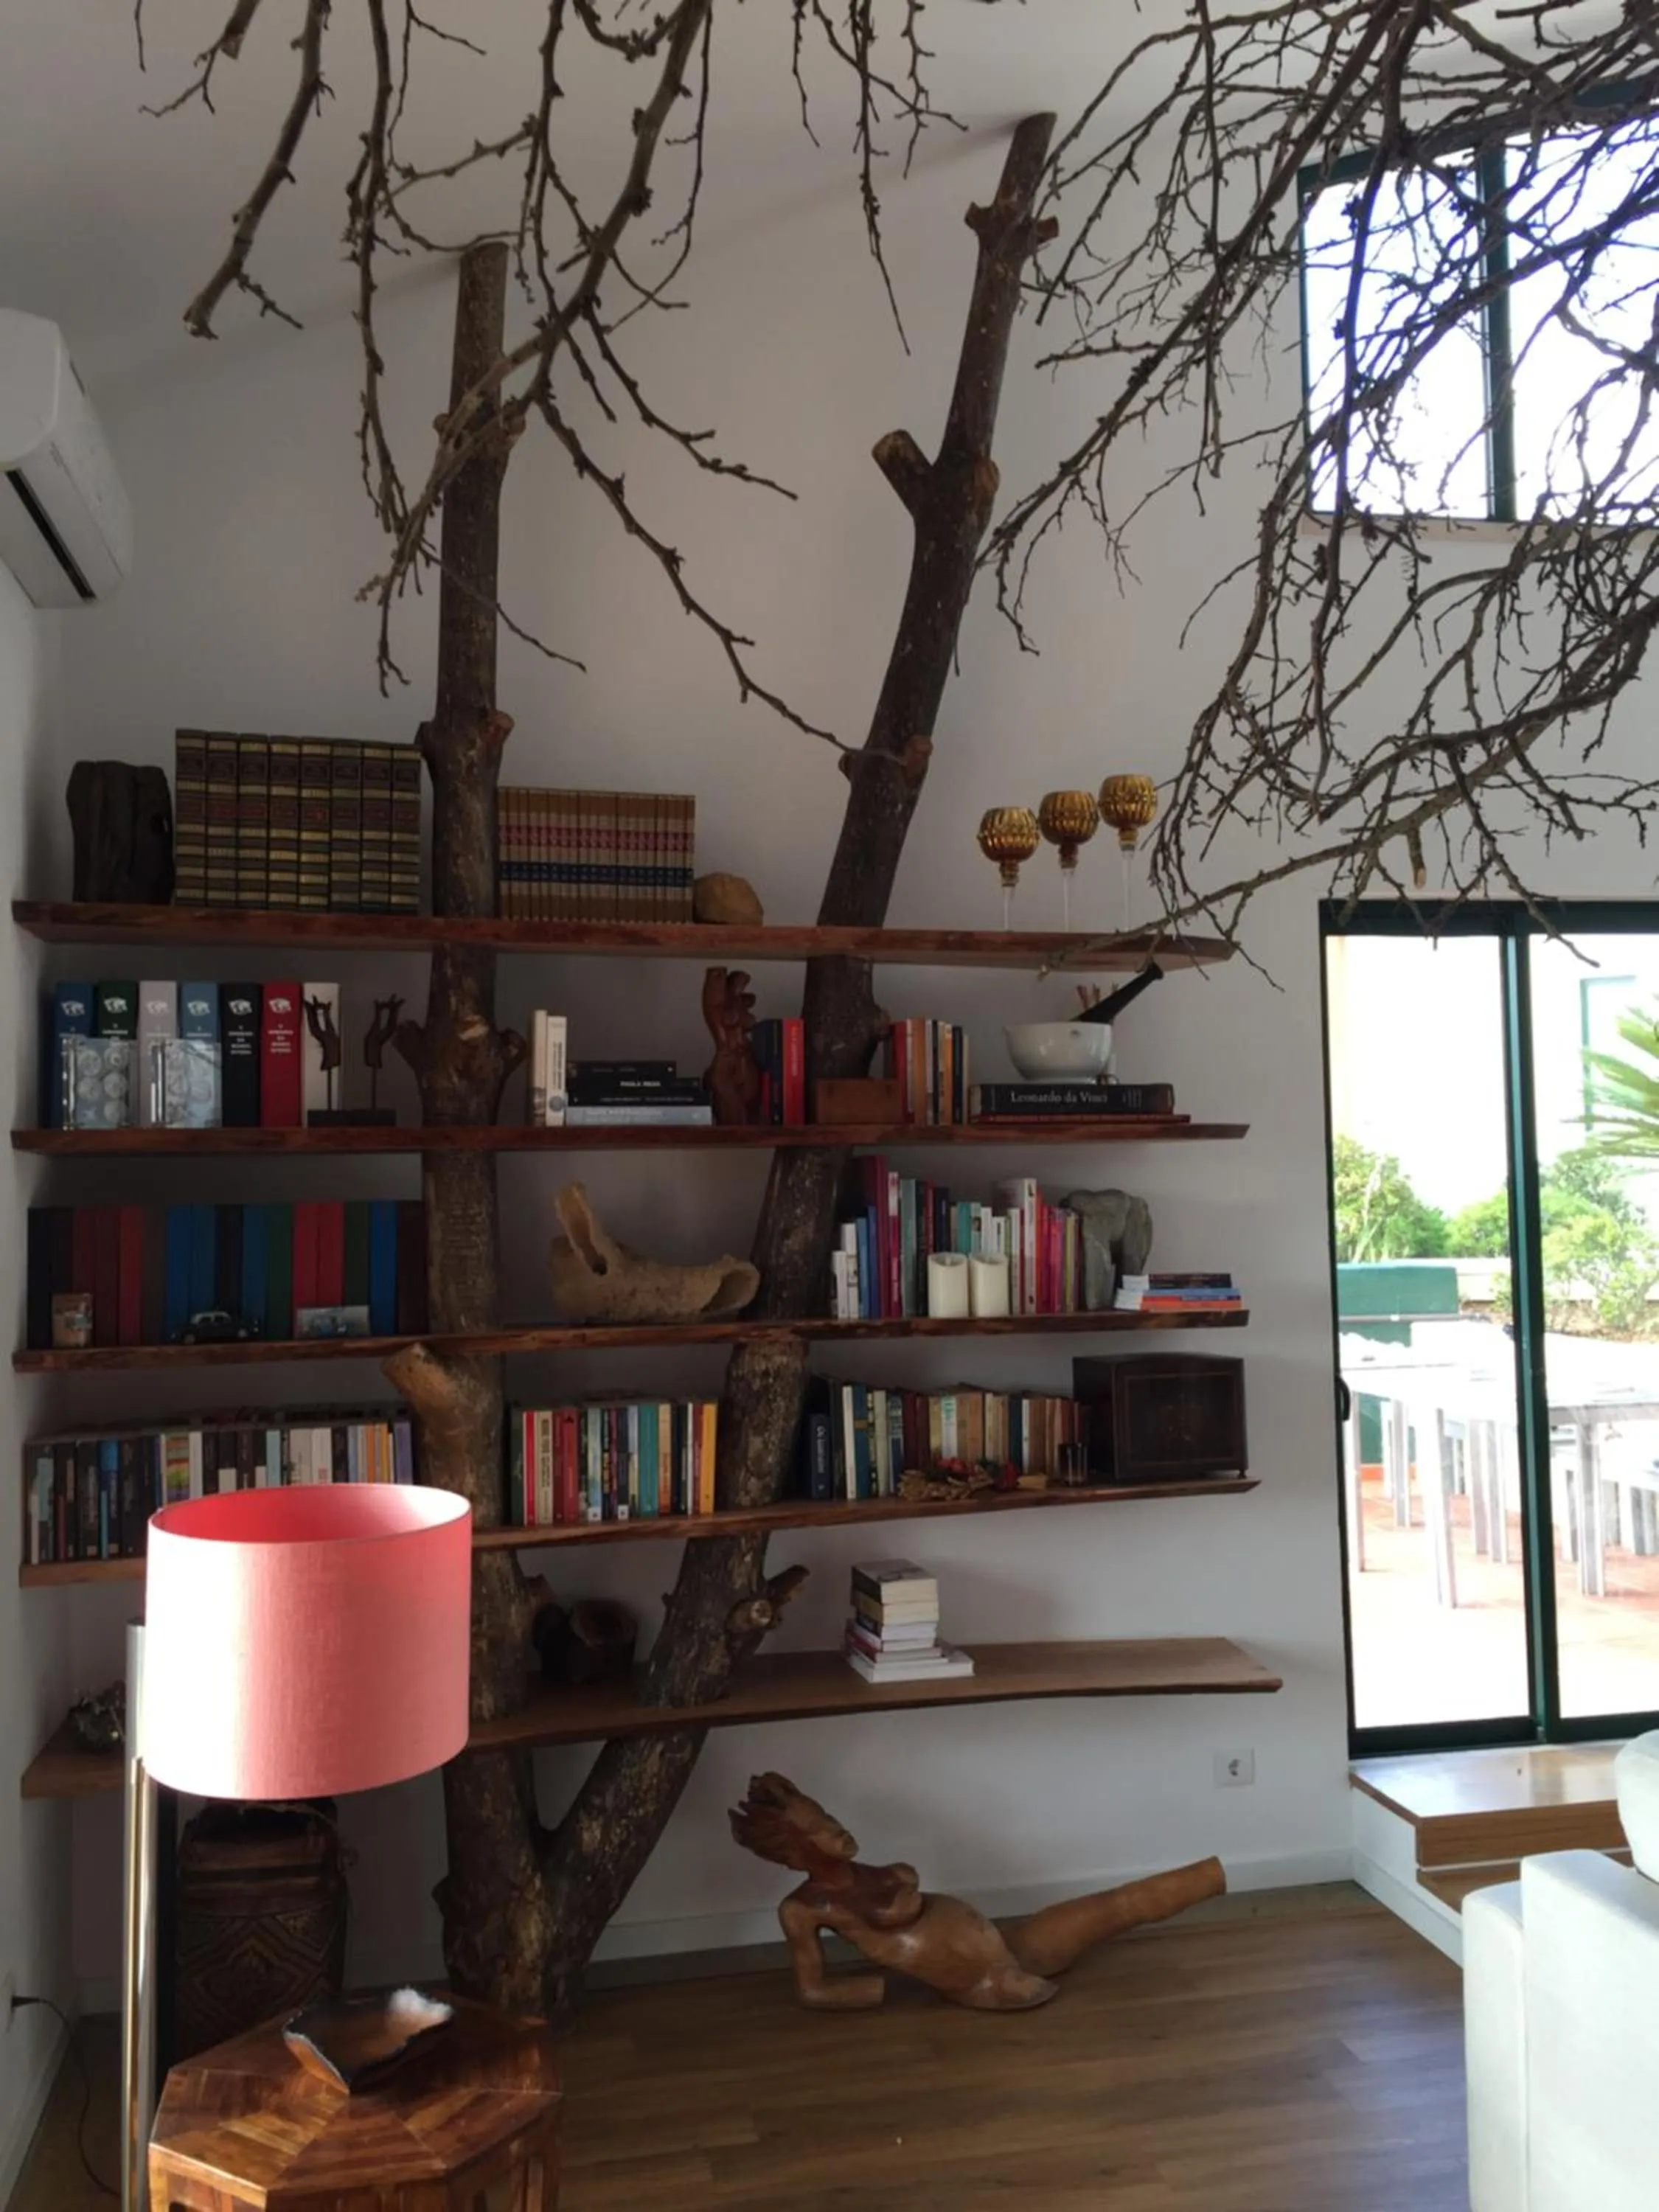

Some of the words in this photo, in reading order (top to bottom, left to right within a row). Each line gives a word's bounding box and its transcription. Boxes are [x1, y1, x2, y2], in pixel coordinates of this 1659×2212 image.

[1011, 1090, 1062, 1103] Leonardo
[1064, 1090, 1077, 1103] da
[1079, 1091, 1108, 1103] Vinci
